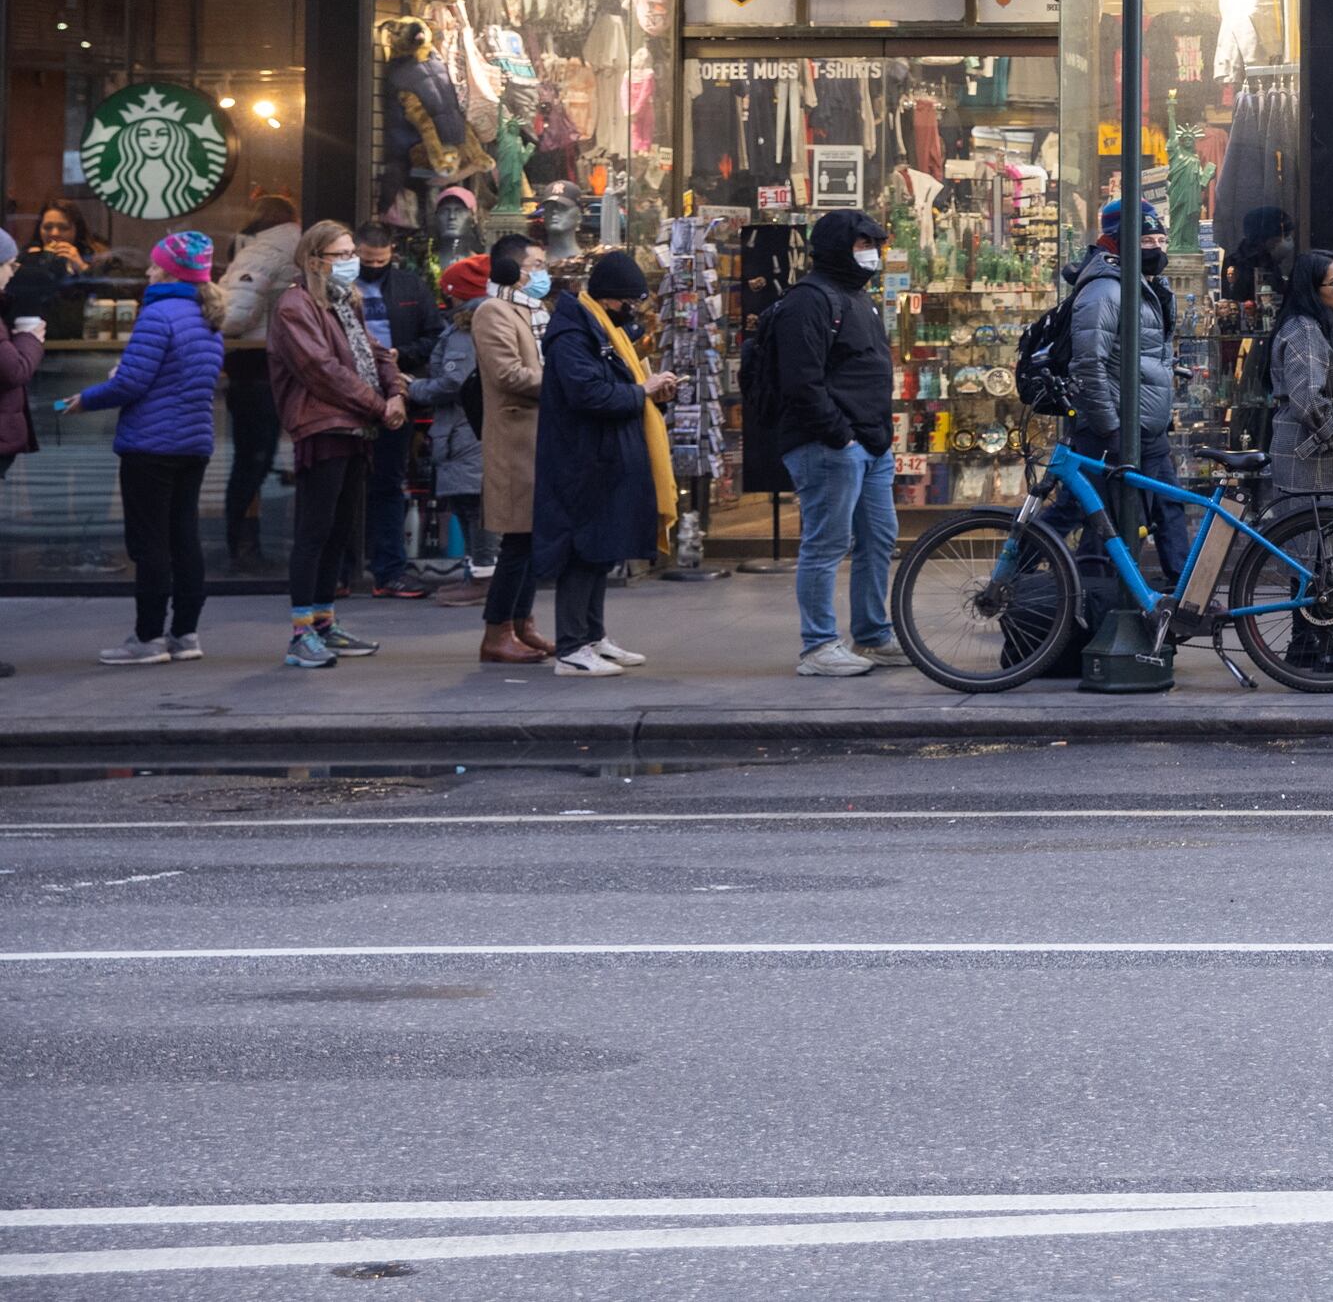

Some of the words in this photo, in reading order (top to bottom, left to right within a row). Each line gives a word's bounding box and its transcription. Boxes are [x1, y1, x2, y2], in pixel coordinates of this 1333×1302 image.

[699, 63, 748, 80] OFFEE
[753, 62, 798, 80] MUGS
[811, 62, 882, 79] T-SHIRTS
